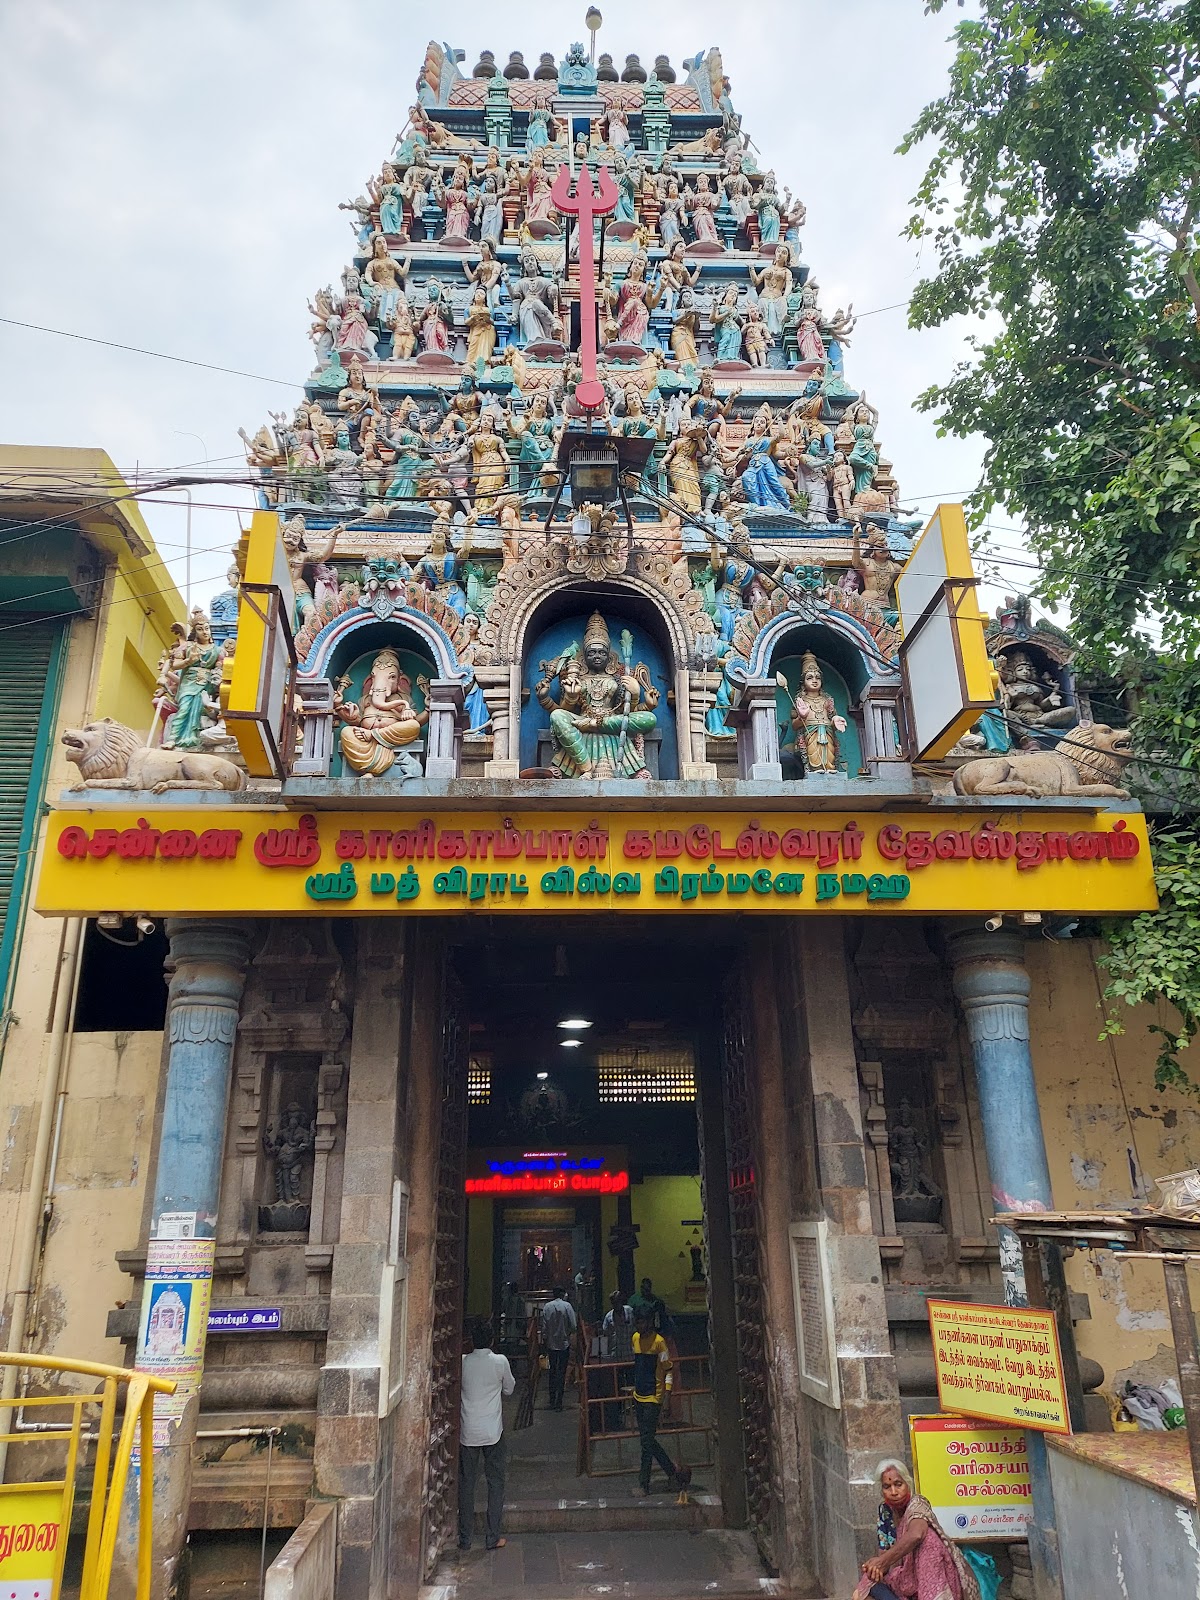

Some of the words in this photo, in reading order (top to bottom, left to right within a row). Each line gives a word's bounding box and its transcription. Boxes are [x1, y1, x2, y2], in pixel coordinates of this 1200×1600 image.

[57, 817, 243, 859] சென்னை
[335, 817, 609, 860] காளிகாம்பாள்
[623, 818, 865, 869] கமடேஸ்வரர்
[877, 819, 1141, 871] தேவஸ்தானம்
[370, 864, 420, 902] மத்
[433, 865, 529, 901] விராட்
[540, 865, 642, 896] விஸ்வ
[654, 863, 805, 901] பிரம்மனே
[816, 872, 911, 902] நமஹ
[251, 1312, 278, 1324] இடம்
[947, 1437, 1027, 1456] ஆலயத்தி
[949, 1459, 1029, 1475] வரிசையா
